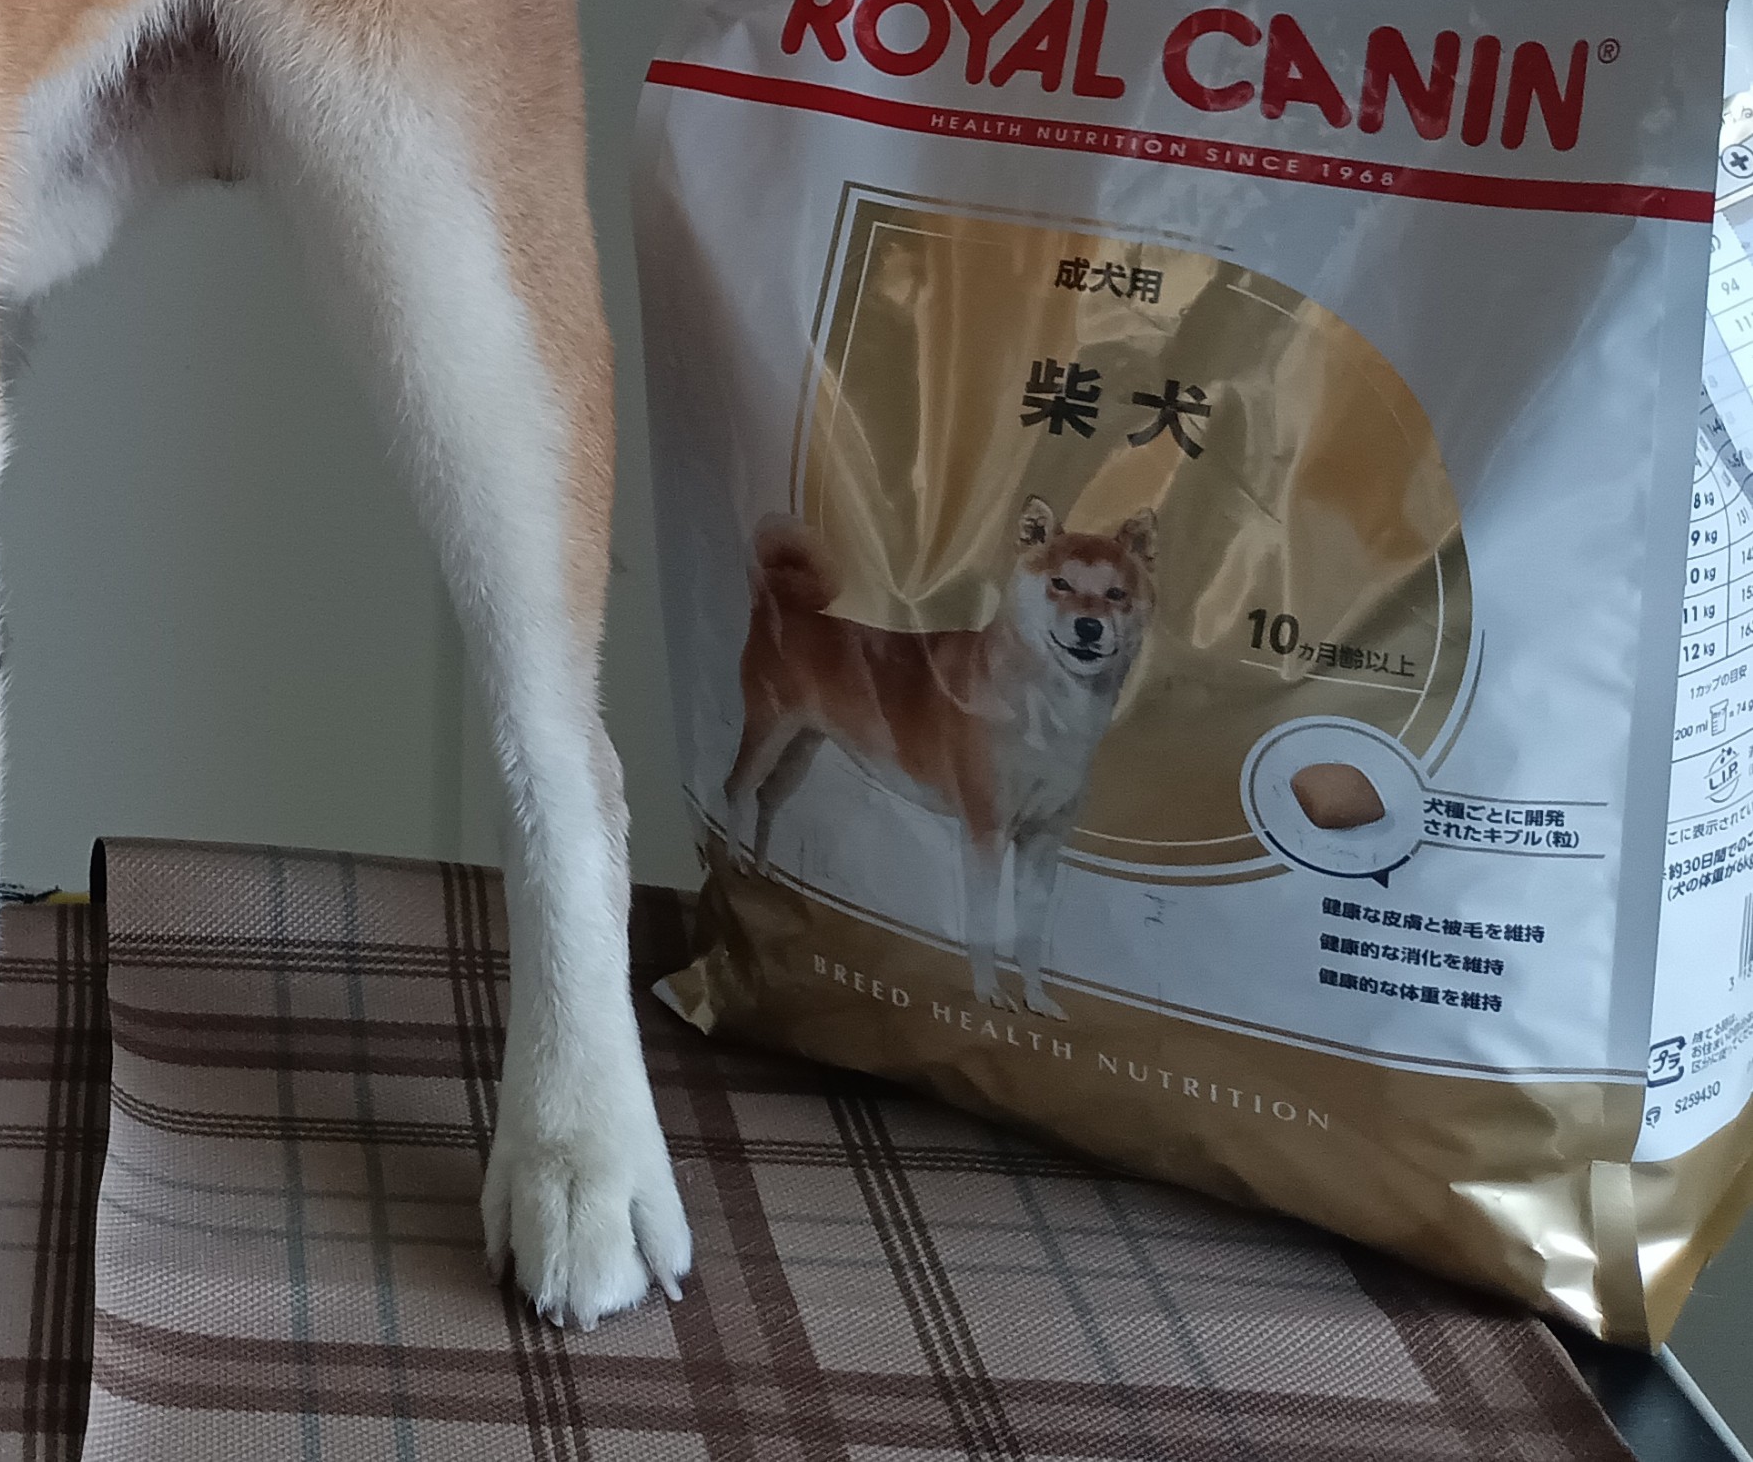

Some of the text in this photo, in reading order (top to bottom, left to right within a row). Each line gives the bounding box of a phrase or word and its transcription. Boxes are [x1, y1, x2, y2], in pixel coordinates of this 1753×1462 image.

[1162, 8, 1589, 152] CANIN
[930, 113, 1395, 187] HEALTH NUTRITION SINCE 1968
[1054, 256, 1164, 304] 成犬用
[1019, 357, 1212, 460] 柴犬
[1704, 490, 1715, 507] kg
[1704, 529, 1718, 545] kg
[1741, 546, 1753, 565] 14
[1690, 565, 1716, 585] 0 kg
[1741, 585, 1753, 603] 15
[1703, 604, 1716, 619] kg
[1740, 620, 1753, 639] 16
[1683, 641, 1716, 662] 12 kg
[1422, 797, 1566, 828] 犬種ごとに開発
[1321, 896, 1546, 944] 健康な皮膚と被毛を維持
[1319, 932, 1505, 976] 健康的な消化を維持
[1318, 967, 1503, 1013] 健康的な体重を維持
[813, 953, 1331, 1131] BREED HEALTH NUTRITION
